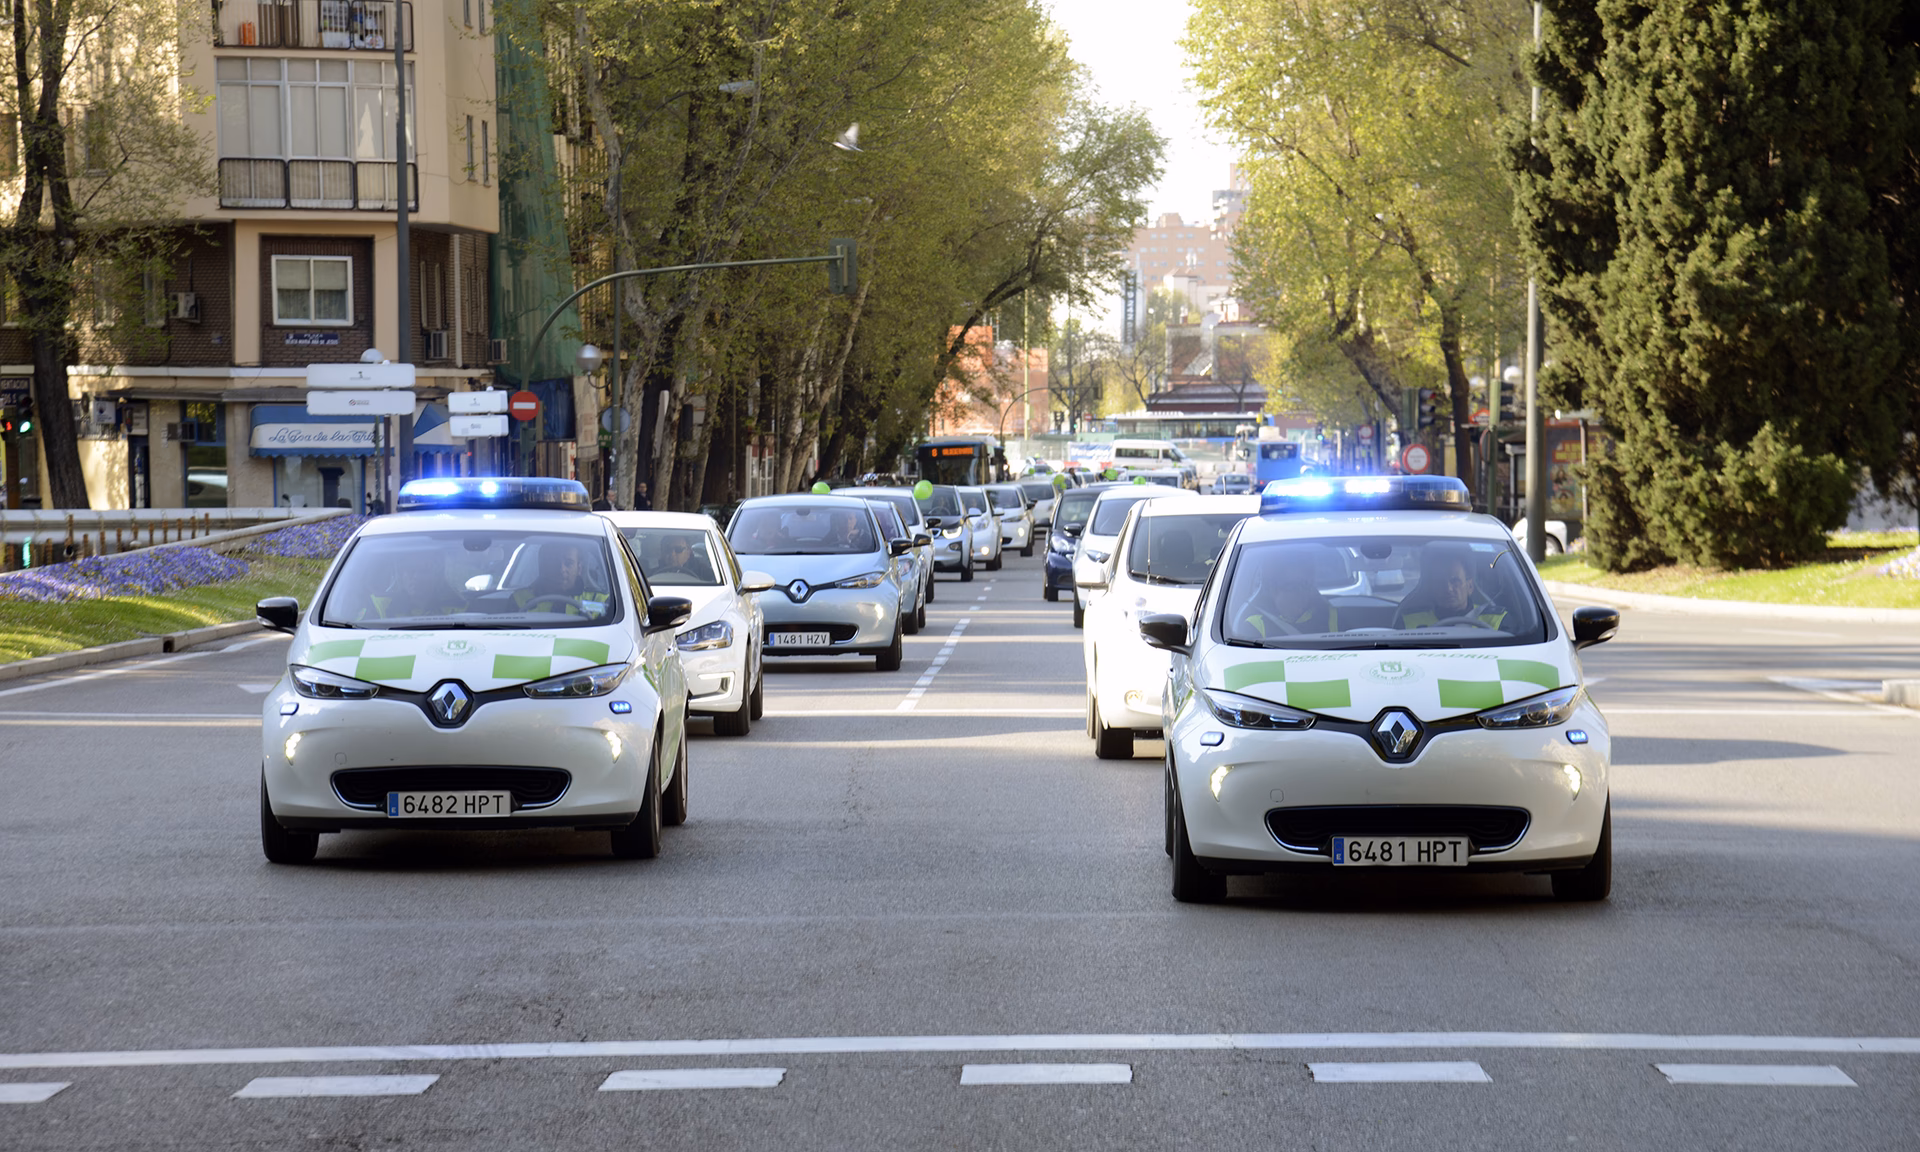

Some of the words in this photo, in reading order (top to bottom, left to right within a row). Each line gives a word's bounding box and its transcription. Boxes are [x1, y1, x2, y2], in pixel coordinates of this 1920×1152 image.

[313, 431, 328, 441] de
[777, 634, 803, 645] 1481
[806, 634, 827, 645] HZV
[403, 795, 458, 814] 6482
[464, 795, 504, 814] HPT
[1349, 841, 1406, 862] 6481
[1417, 841, 1462, 862] HPT
